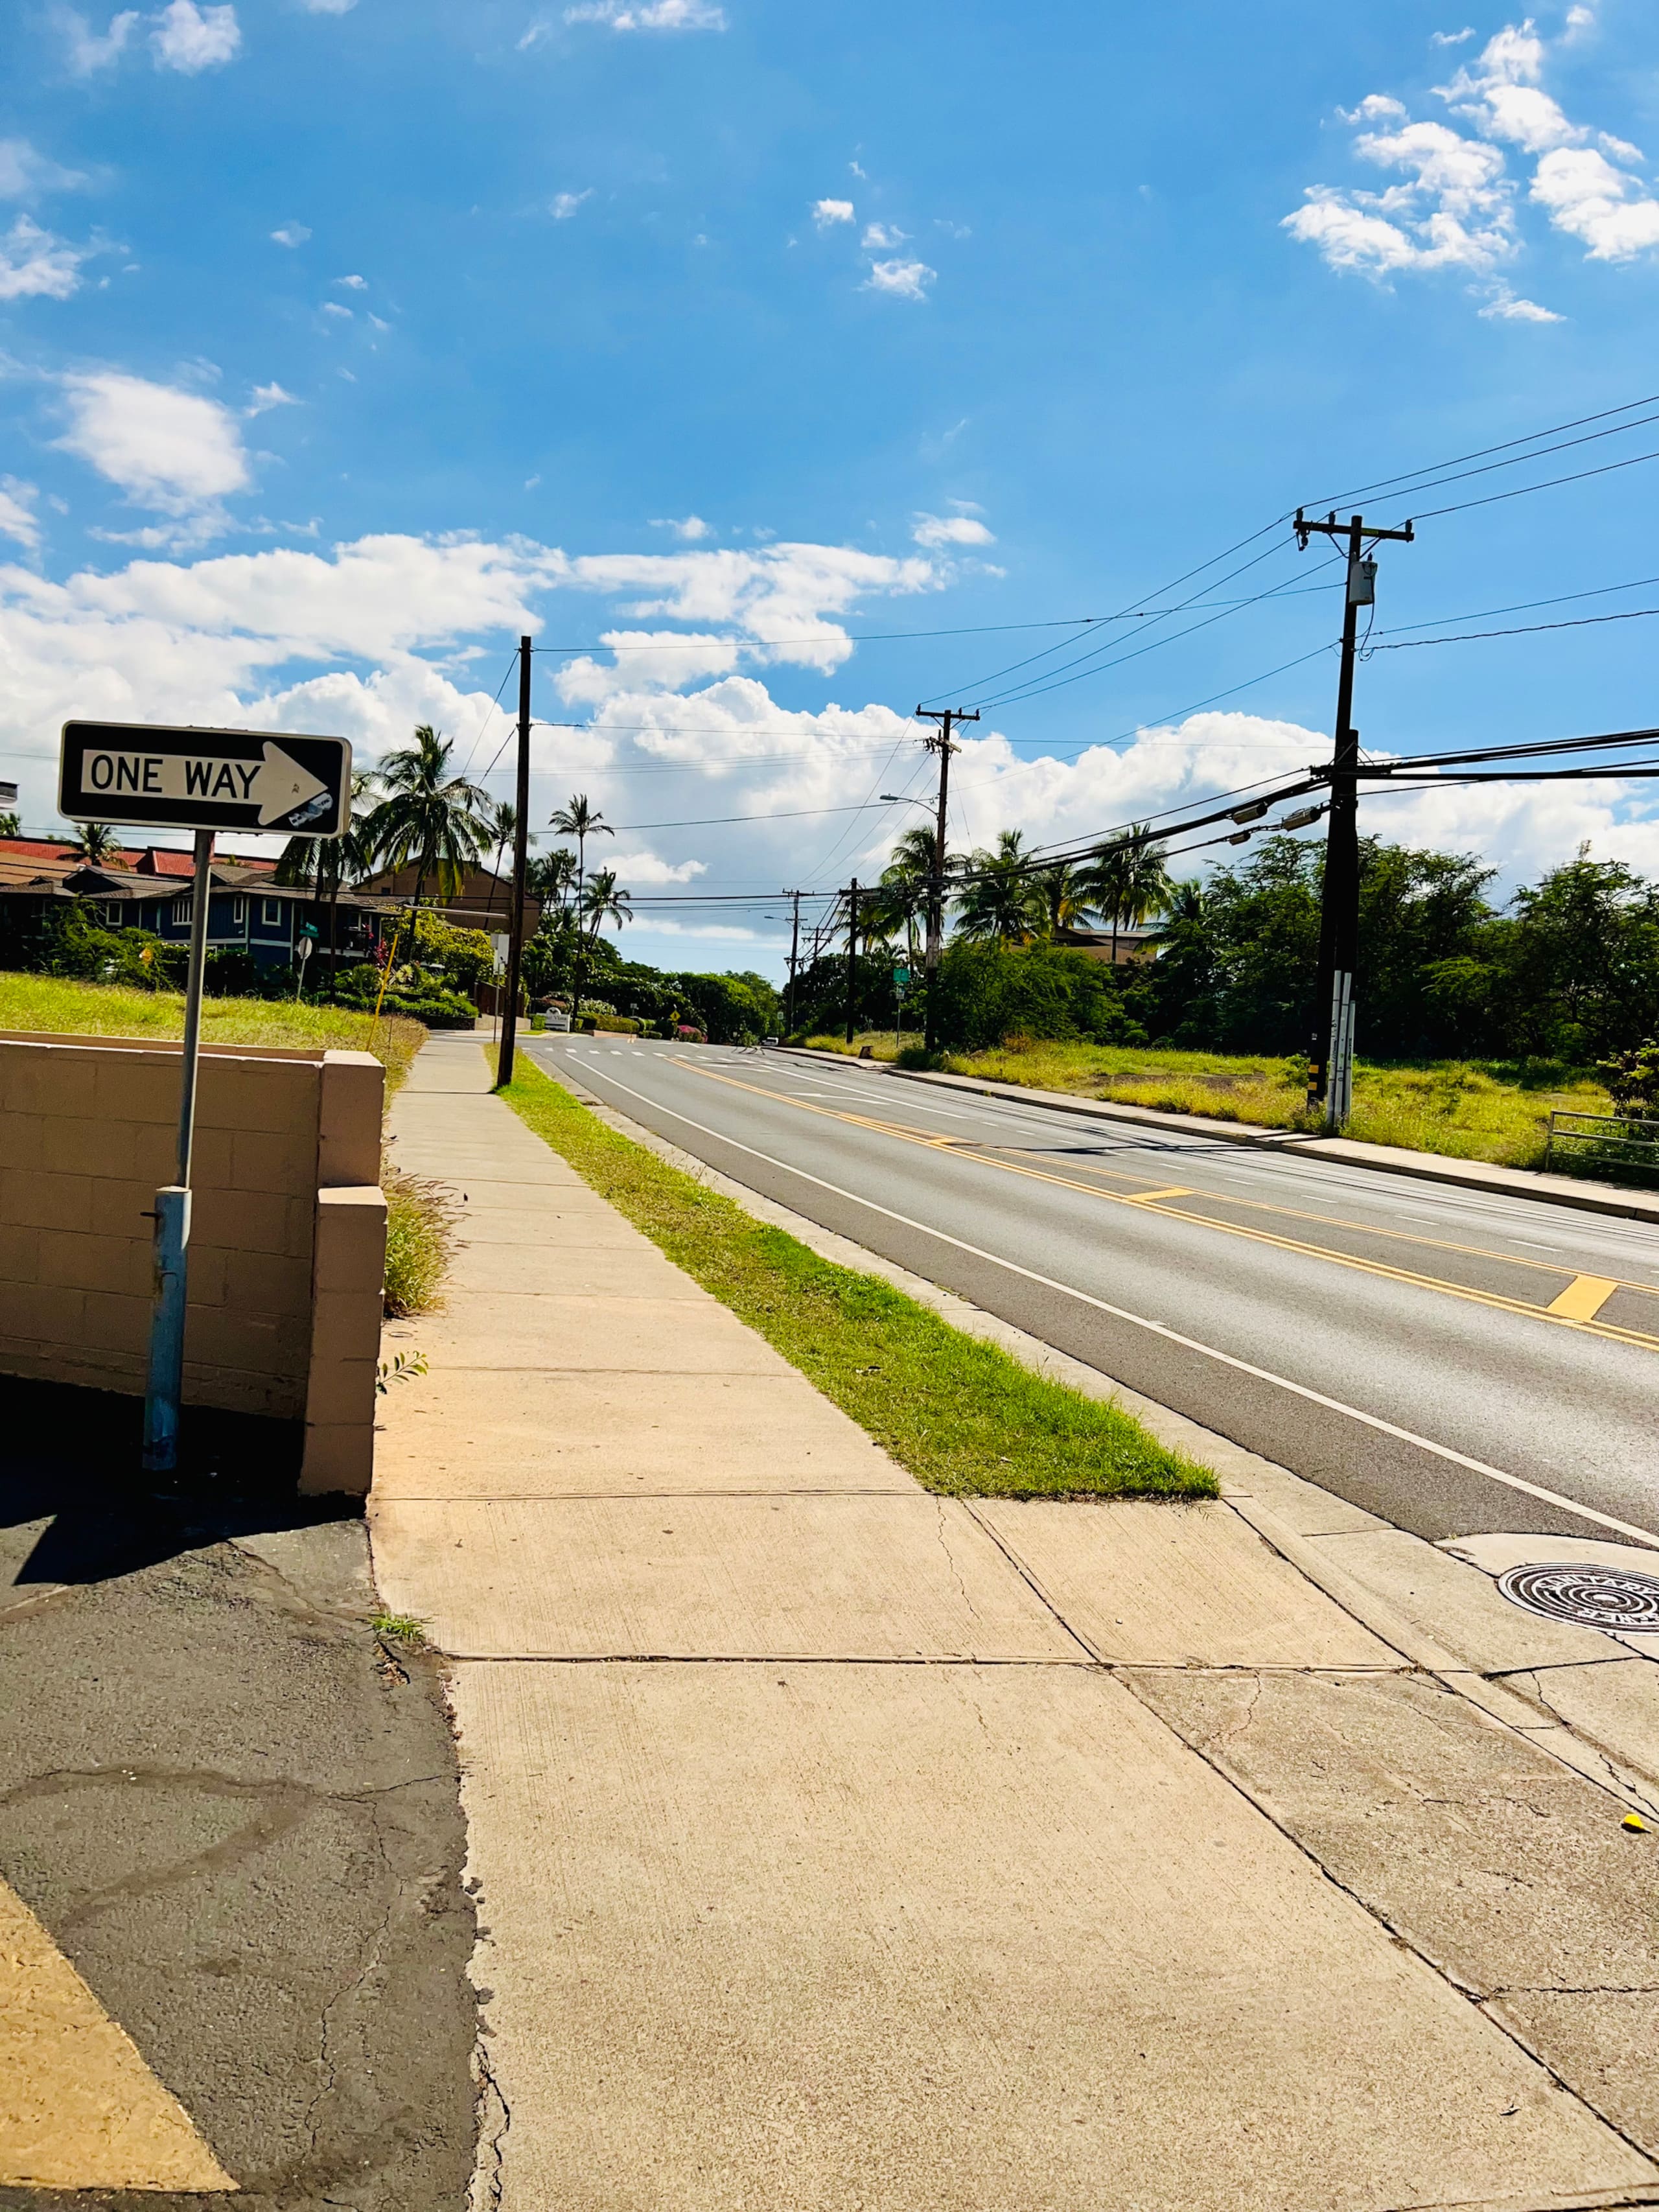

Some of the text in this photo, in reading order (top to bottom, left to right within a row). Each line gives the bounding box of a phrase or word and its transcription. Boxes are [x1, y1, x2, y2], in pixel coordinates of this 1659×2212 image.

[91, 754, 261, 799] ONE WAY
[1538, 1575, 1659, 1594] SANITARY
[1577, 1607, 1659, 1624] SEWER
